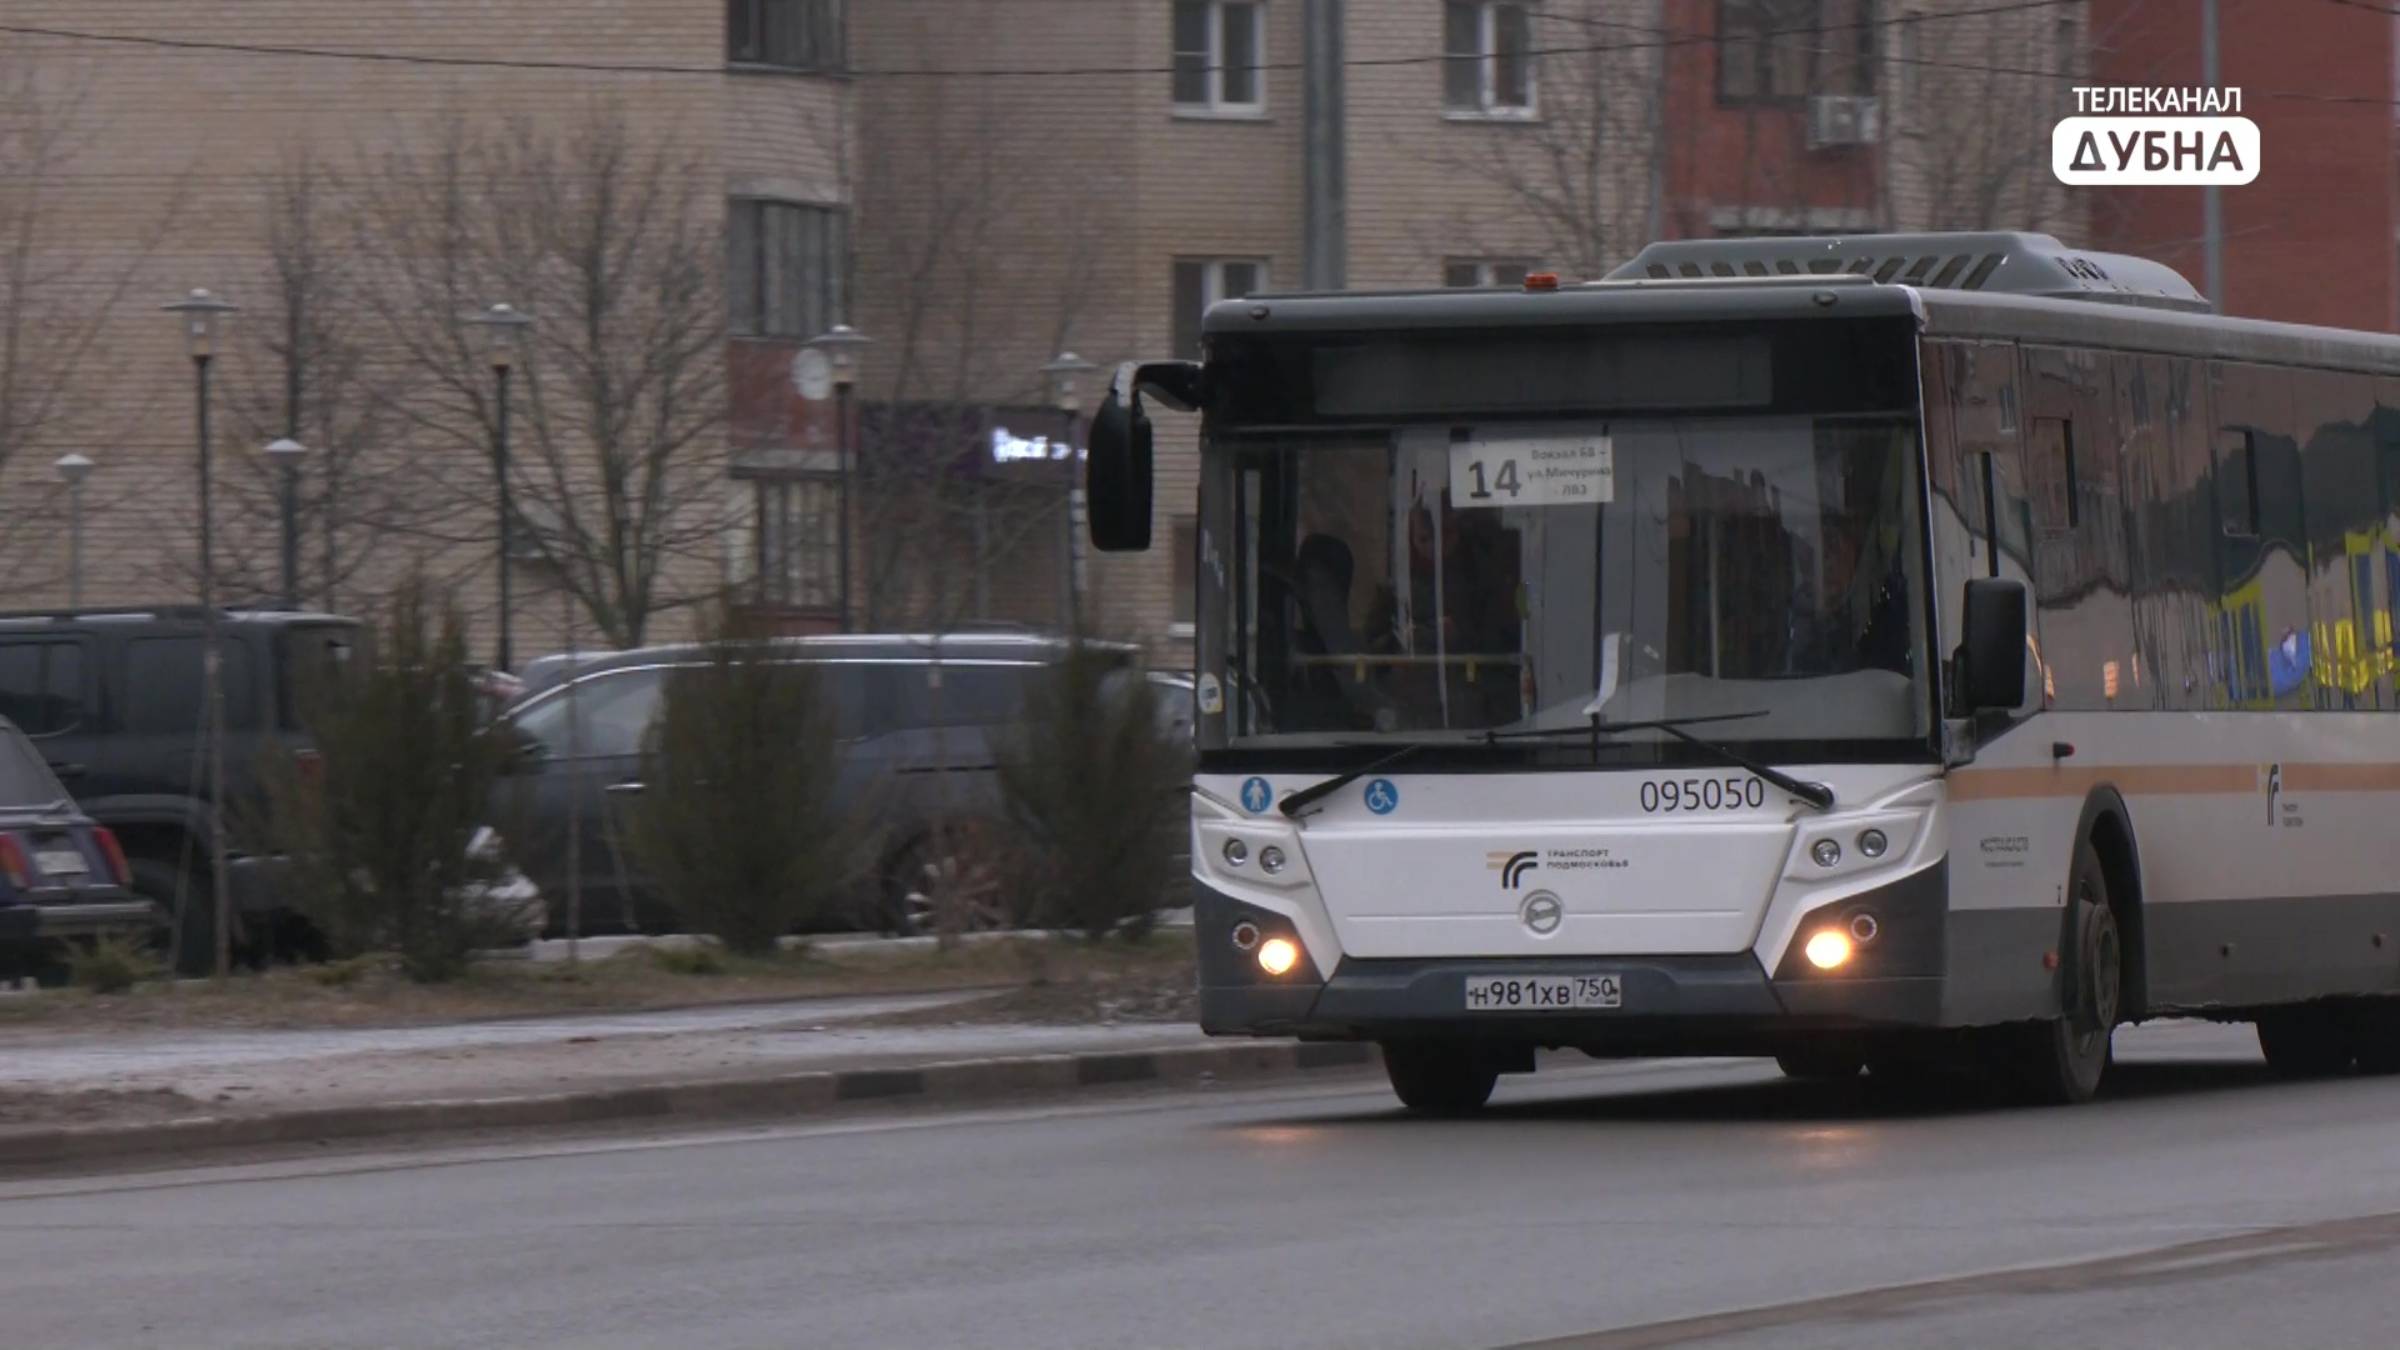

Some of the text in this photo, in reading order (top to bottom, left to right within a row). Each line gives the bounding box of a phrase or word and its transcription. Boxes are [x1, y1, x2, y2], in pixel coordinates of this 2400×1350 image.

[1468, 459, 1522, 499] 14
[1640, 777, 1764, 812] 095050
[1547, 849, 1609, 857] ТРАНСПОРТ
[1576, 978, 1613, 998] 750
